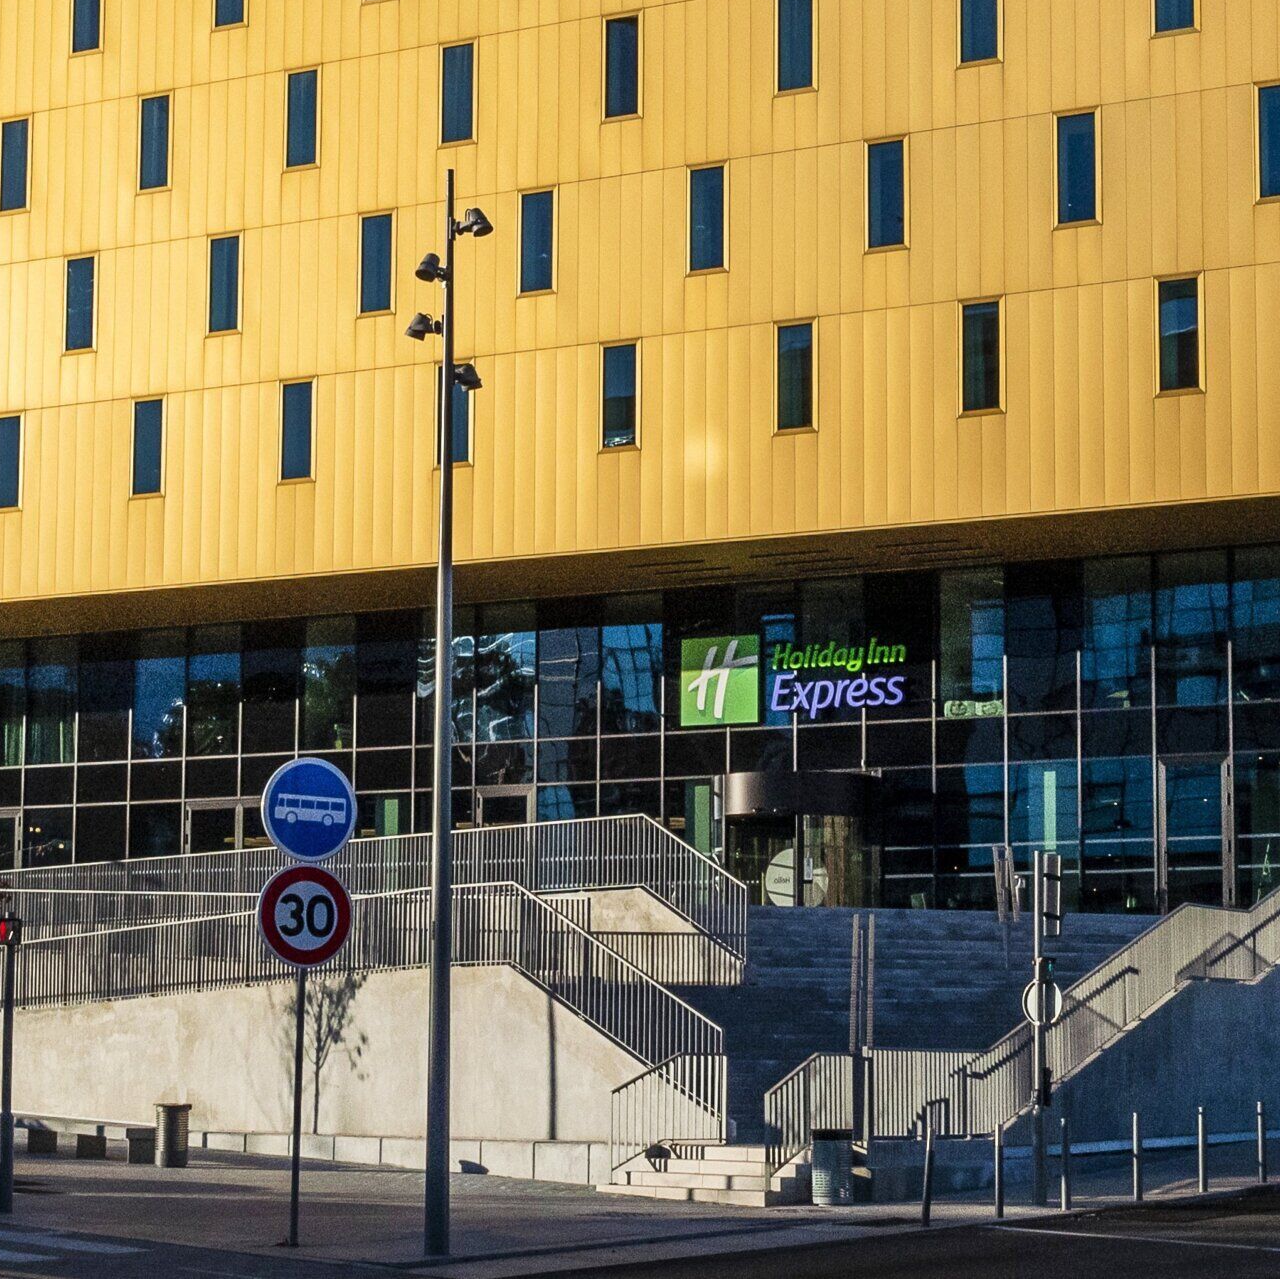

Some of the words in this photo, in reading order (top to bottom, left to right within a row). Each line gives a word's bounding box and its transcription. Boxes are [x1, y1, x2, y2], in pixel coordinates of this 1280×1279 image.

[771, 640, 865, 671] Holiday
[867, 637, 907, 665] Inn
[771, 674, 906, 719] Express
[278, 893, 336, 938] 30
